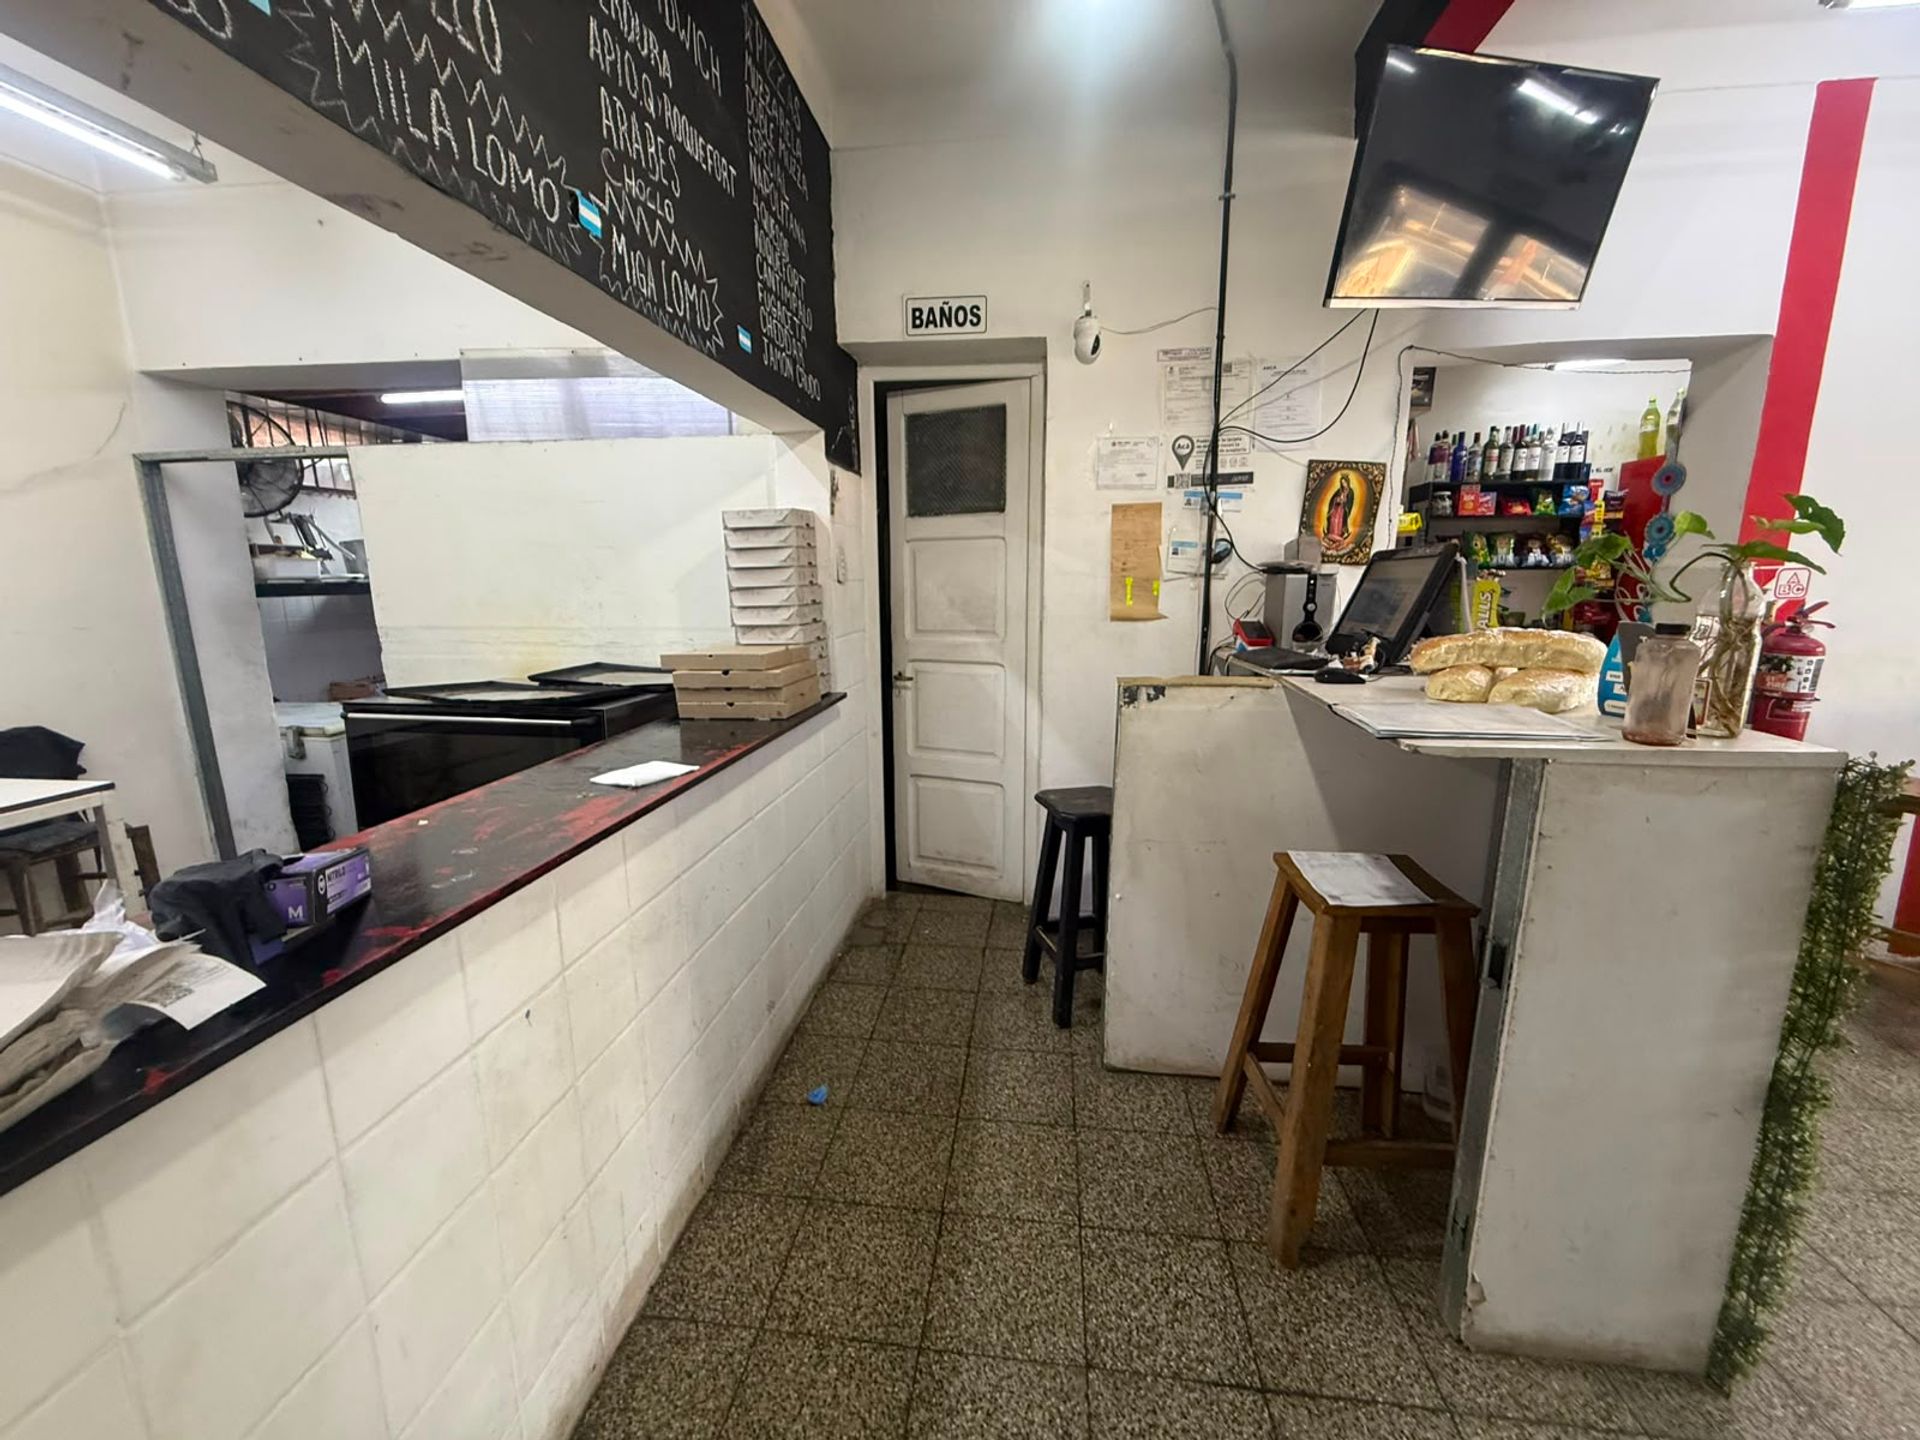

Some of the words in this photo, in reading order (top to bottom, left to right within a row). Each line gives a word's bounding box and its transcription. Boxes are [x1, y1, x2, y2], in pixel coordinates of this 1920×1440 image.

[330, 16, 459, 160] MILA
[467, 117, 560, 223] LOMO
[600, 86, 681, 198] ARABES
[662, 92, 737, 198] ROQUEFORT
[600, 147, 675, 224] CHOCLO
[611, 225, 657, 303] MIGA
[661, 258, 712, 332] LOMO
[911, 301, 982, 329] BAÑOS
[1478, 591, 1492, 631] ALLS
[288, 906, 303, 918] M
